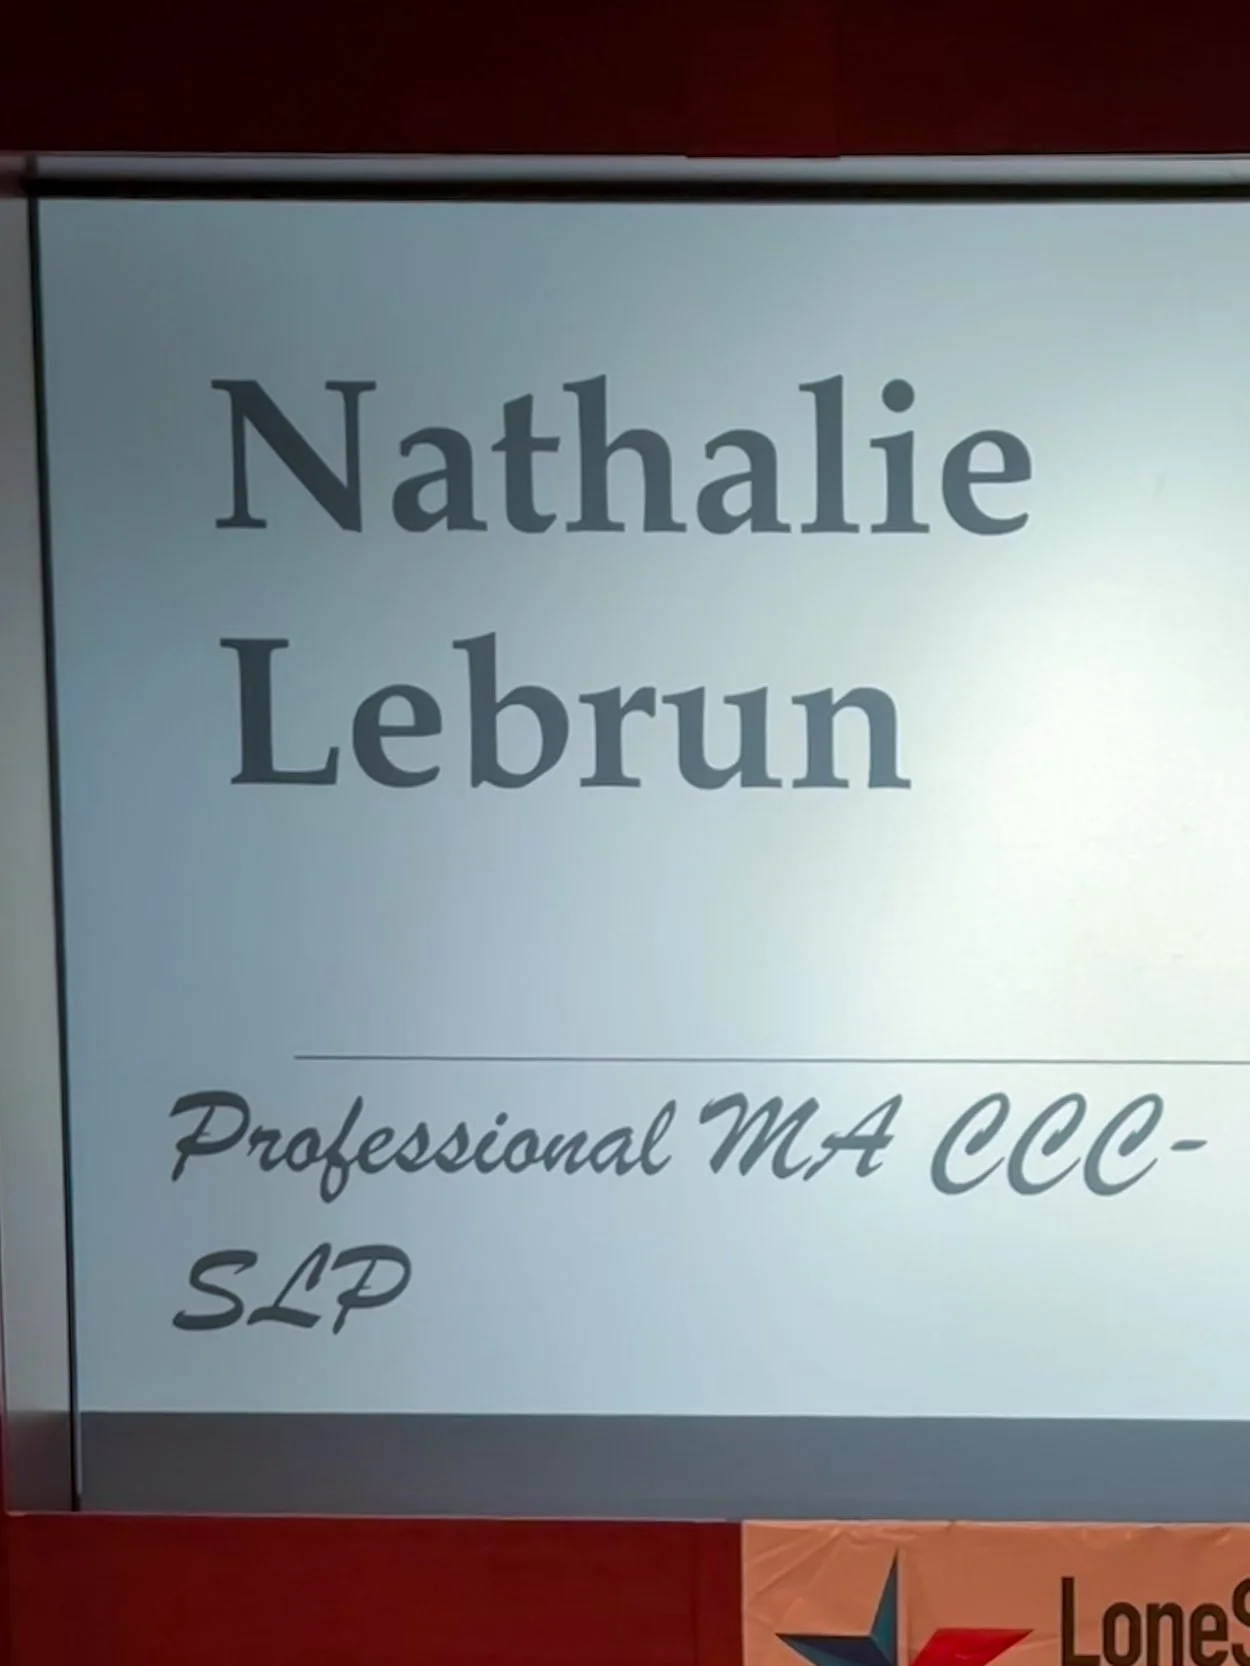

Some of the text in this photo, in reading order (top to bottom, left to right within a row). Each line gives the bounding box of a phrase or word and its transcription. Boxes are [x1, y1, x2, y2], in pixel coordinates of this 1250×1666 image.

[211, 374, 1032, 536] Nathalie
[220, 632, 912, 790] Lebrun
[169, 1090, 1208, 1203] Professional MA CCC-
[172, 1242, 412, 1335] SLP
